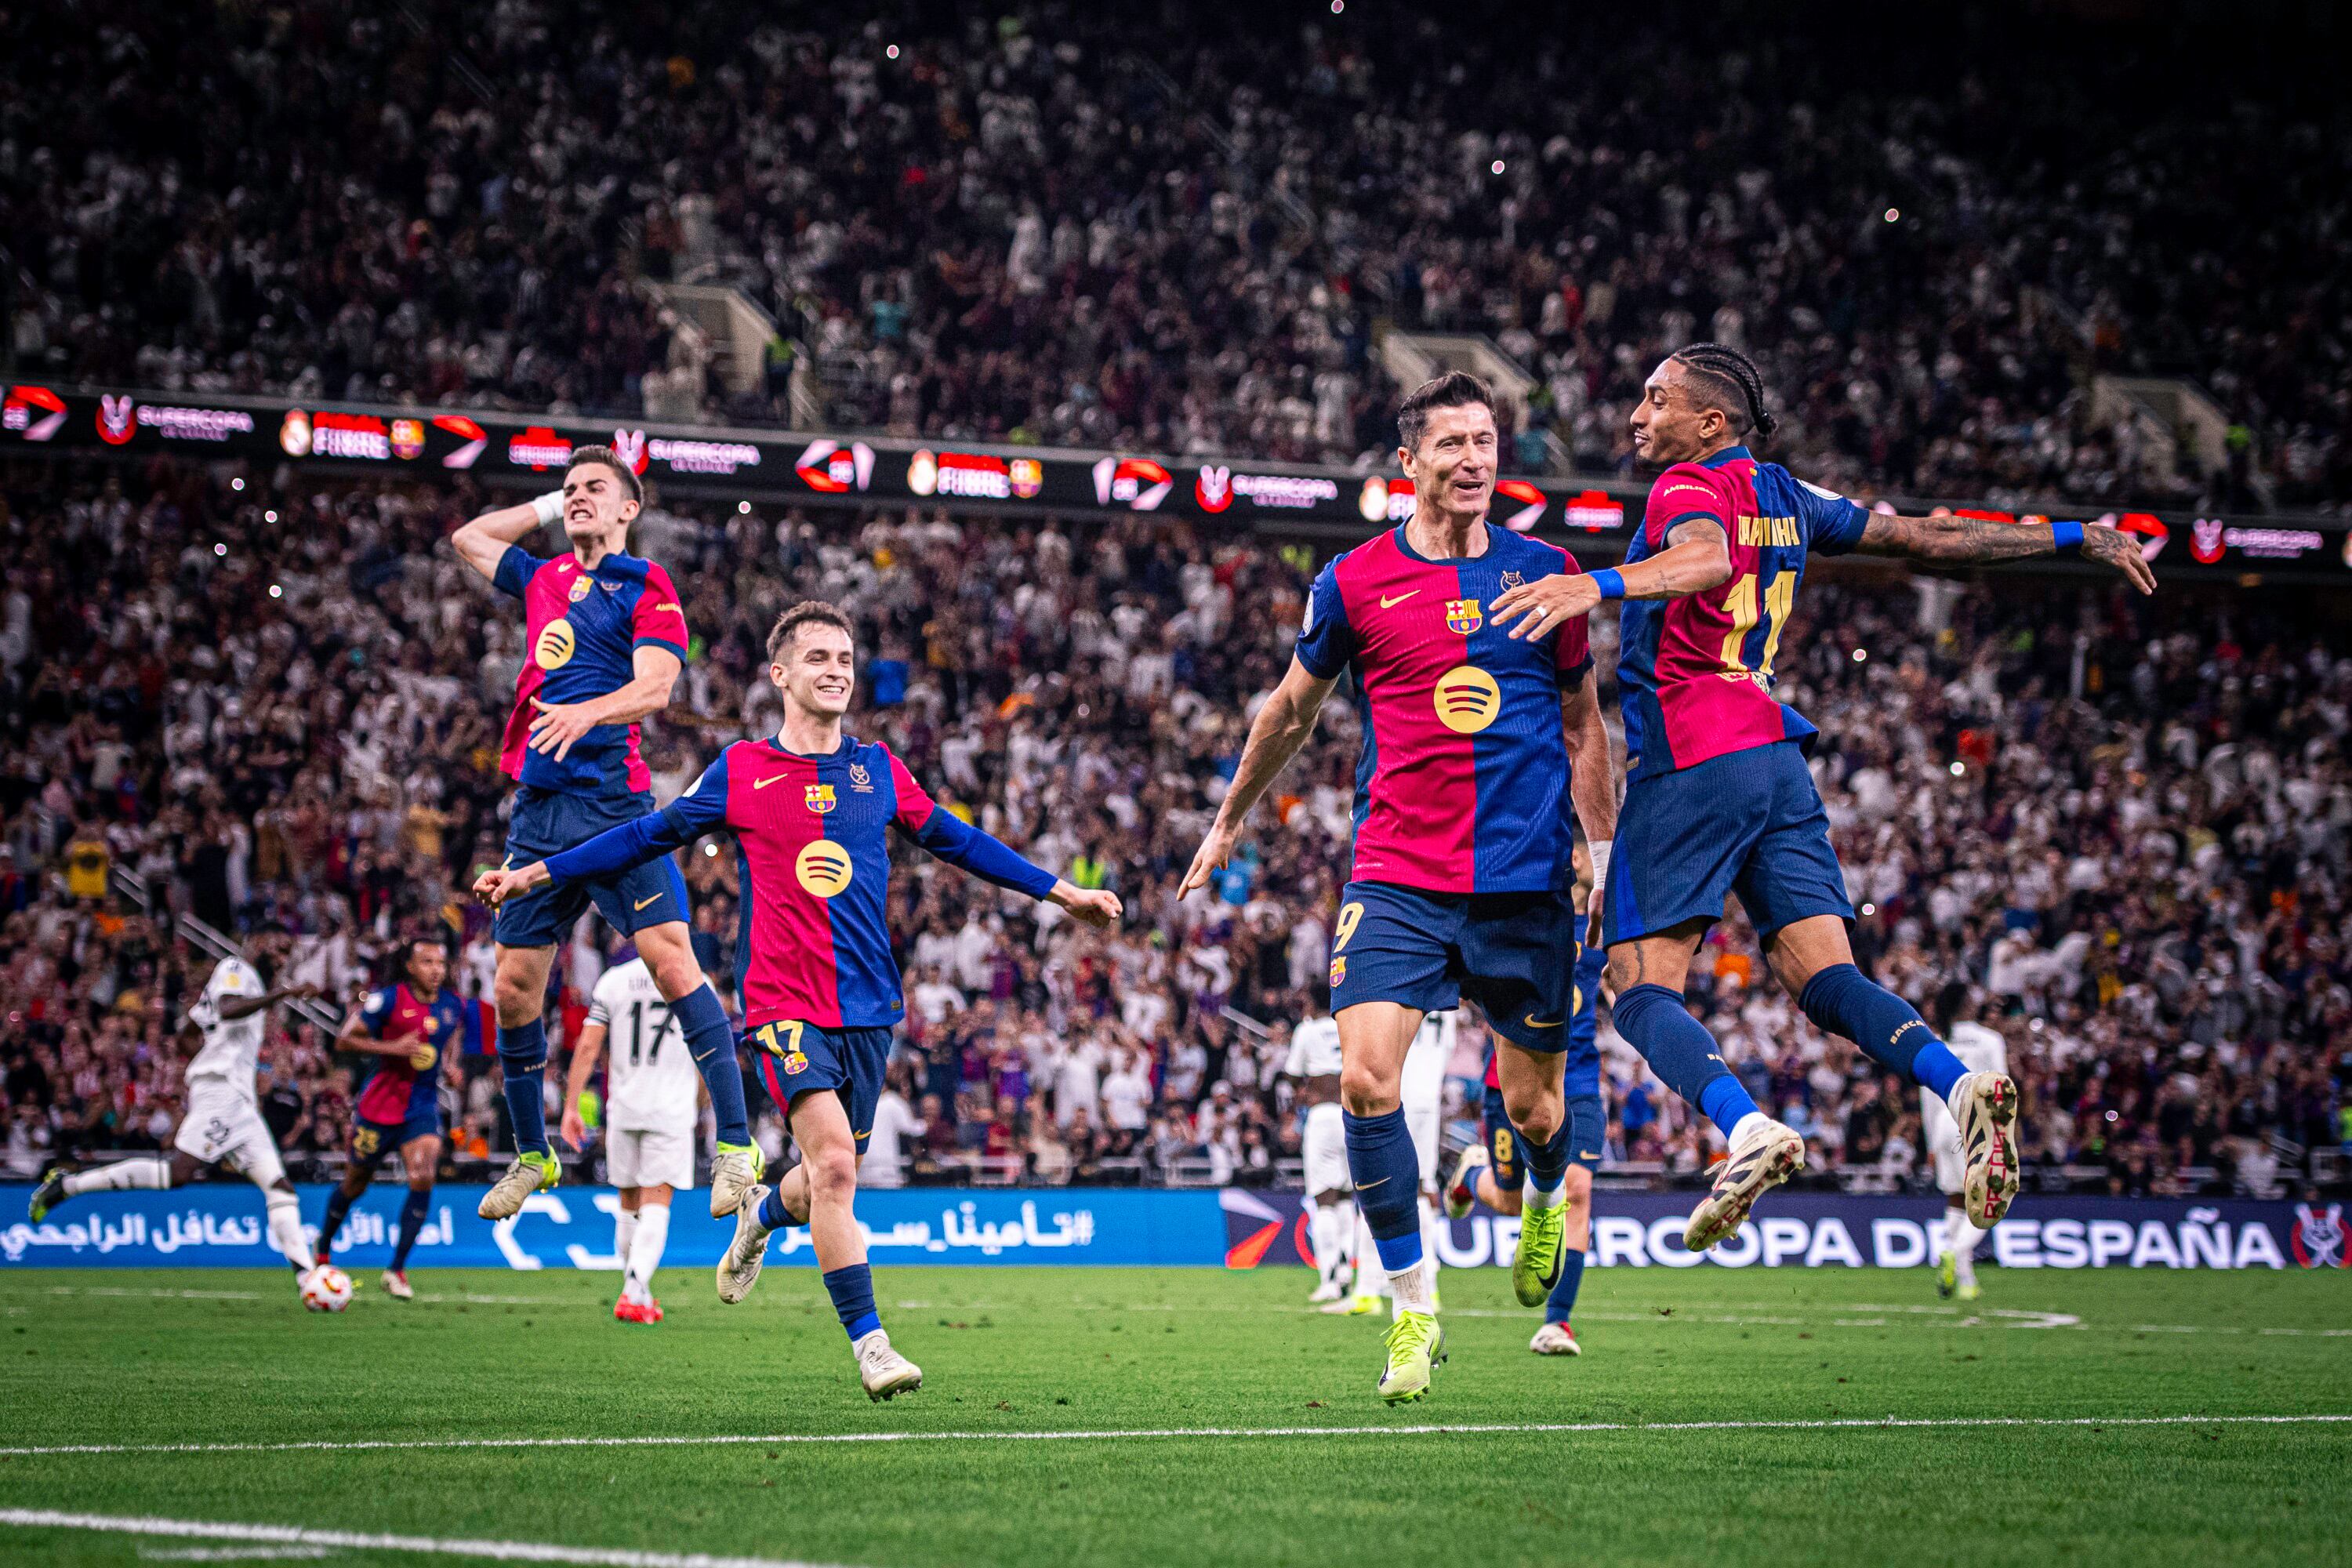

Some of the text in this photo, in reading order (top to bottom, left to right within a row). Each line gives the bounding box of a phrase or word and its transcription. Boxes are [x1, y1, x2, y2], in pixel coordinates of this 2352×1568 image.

[1720, 571, 1797, 676] 11
[1333, 902, 1365, 953] 9
[630, 1001, 675, 1065] 17
[756, 1019, 804, 1061] 17
[1494, 1127, 1513, 1163] 8
[0, 1212, 147, 1261] الراجحي
[152, 1208, 261, 1254] تكافل
[1992, 1206, 2286, 1270] ESPAÑA
